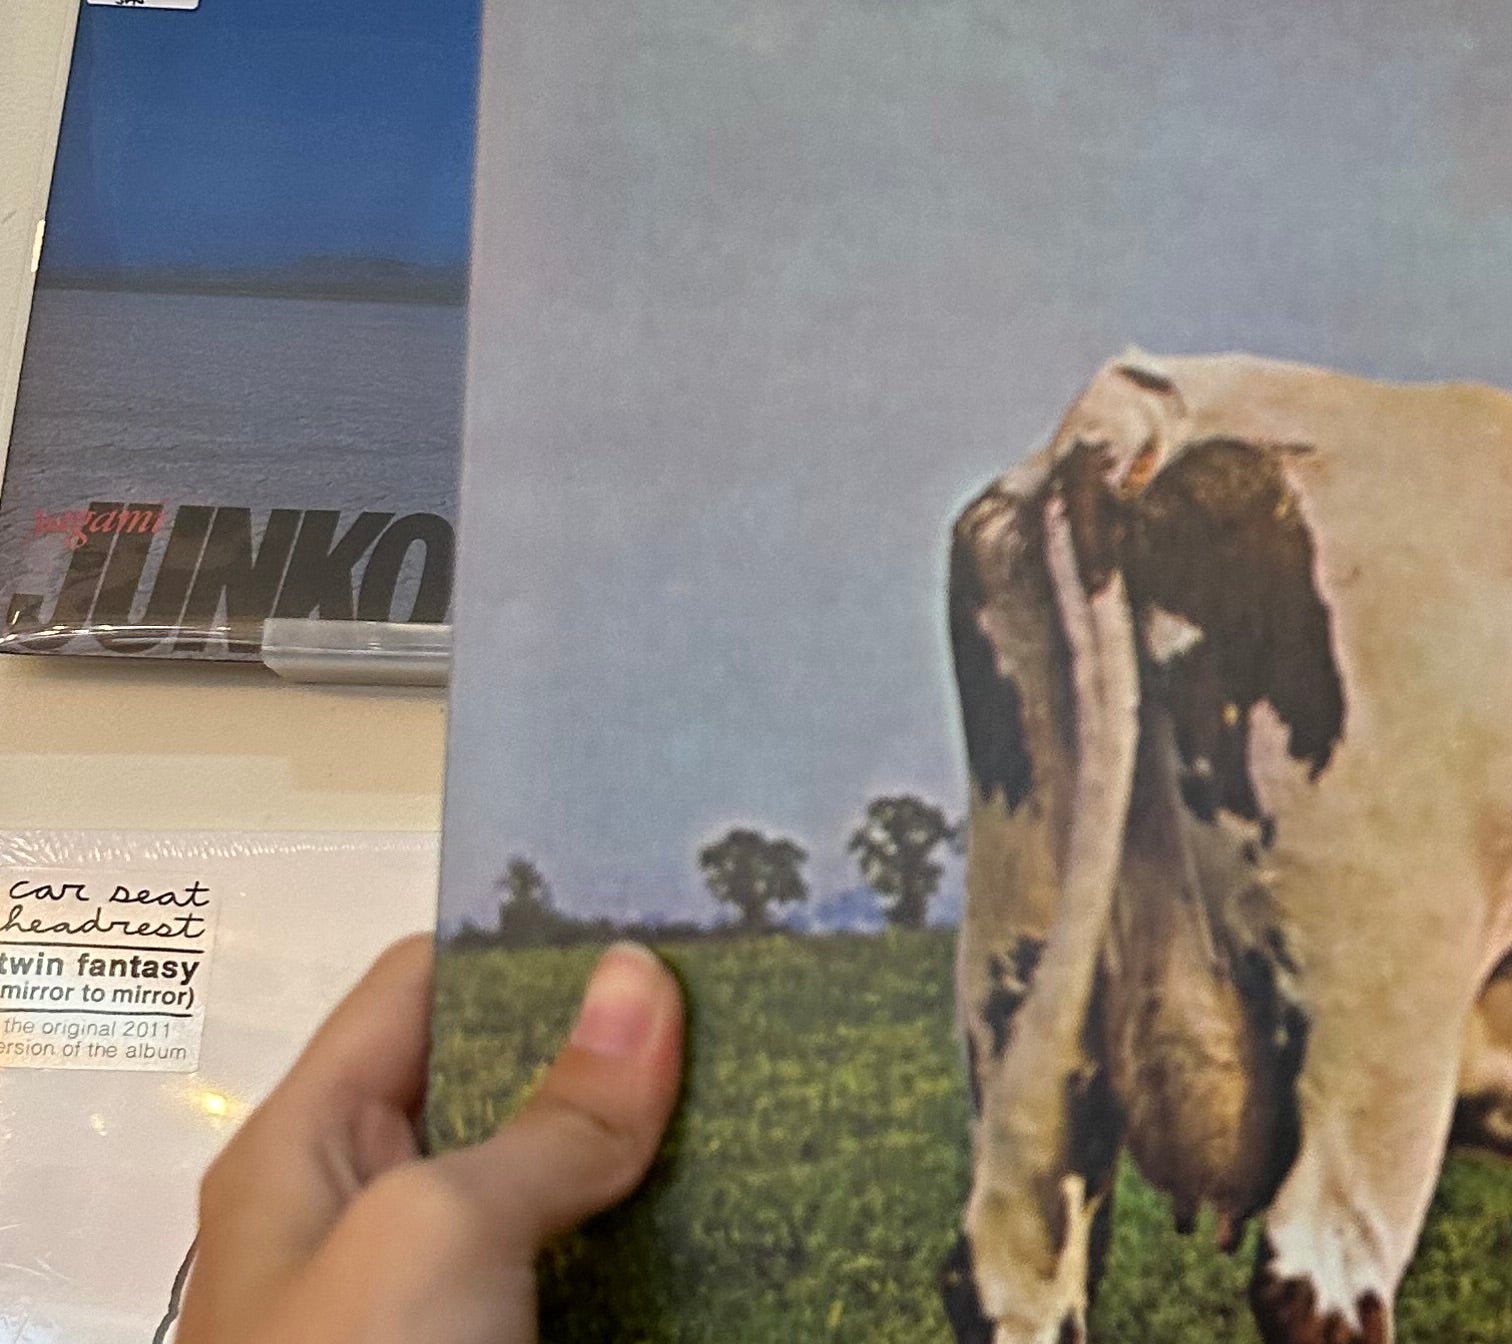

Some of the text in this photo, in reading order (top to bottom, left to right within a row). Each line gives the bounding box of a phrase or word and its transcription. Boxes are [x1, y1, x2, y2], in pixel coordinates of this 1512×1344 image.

[6, 500, 457, 654] JUNKO
[9, 880, 210, 907] car seat
[0, 904, 206, 939] headrest
[0, 951, 201, 986] twin fantasy
[82, 984, 105, 1002] to
[111, 984, 195, 1010] mirror)
[4, 1016, 171, 1039] the original 2011
[62, 1040, 81, 1057] of
[87, 1041, 118, 1058] the
[125, 1042, 187, 1061] album
